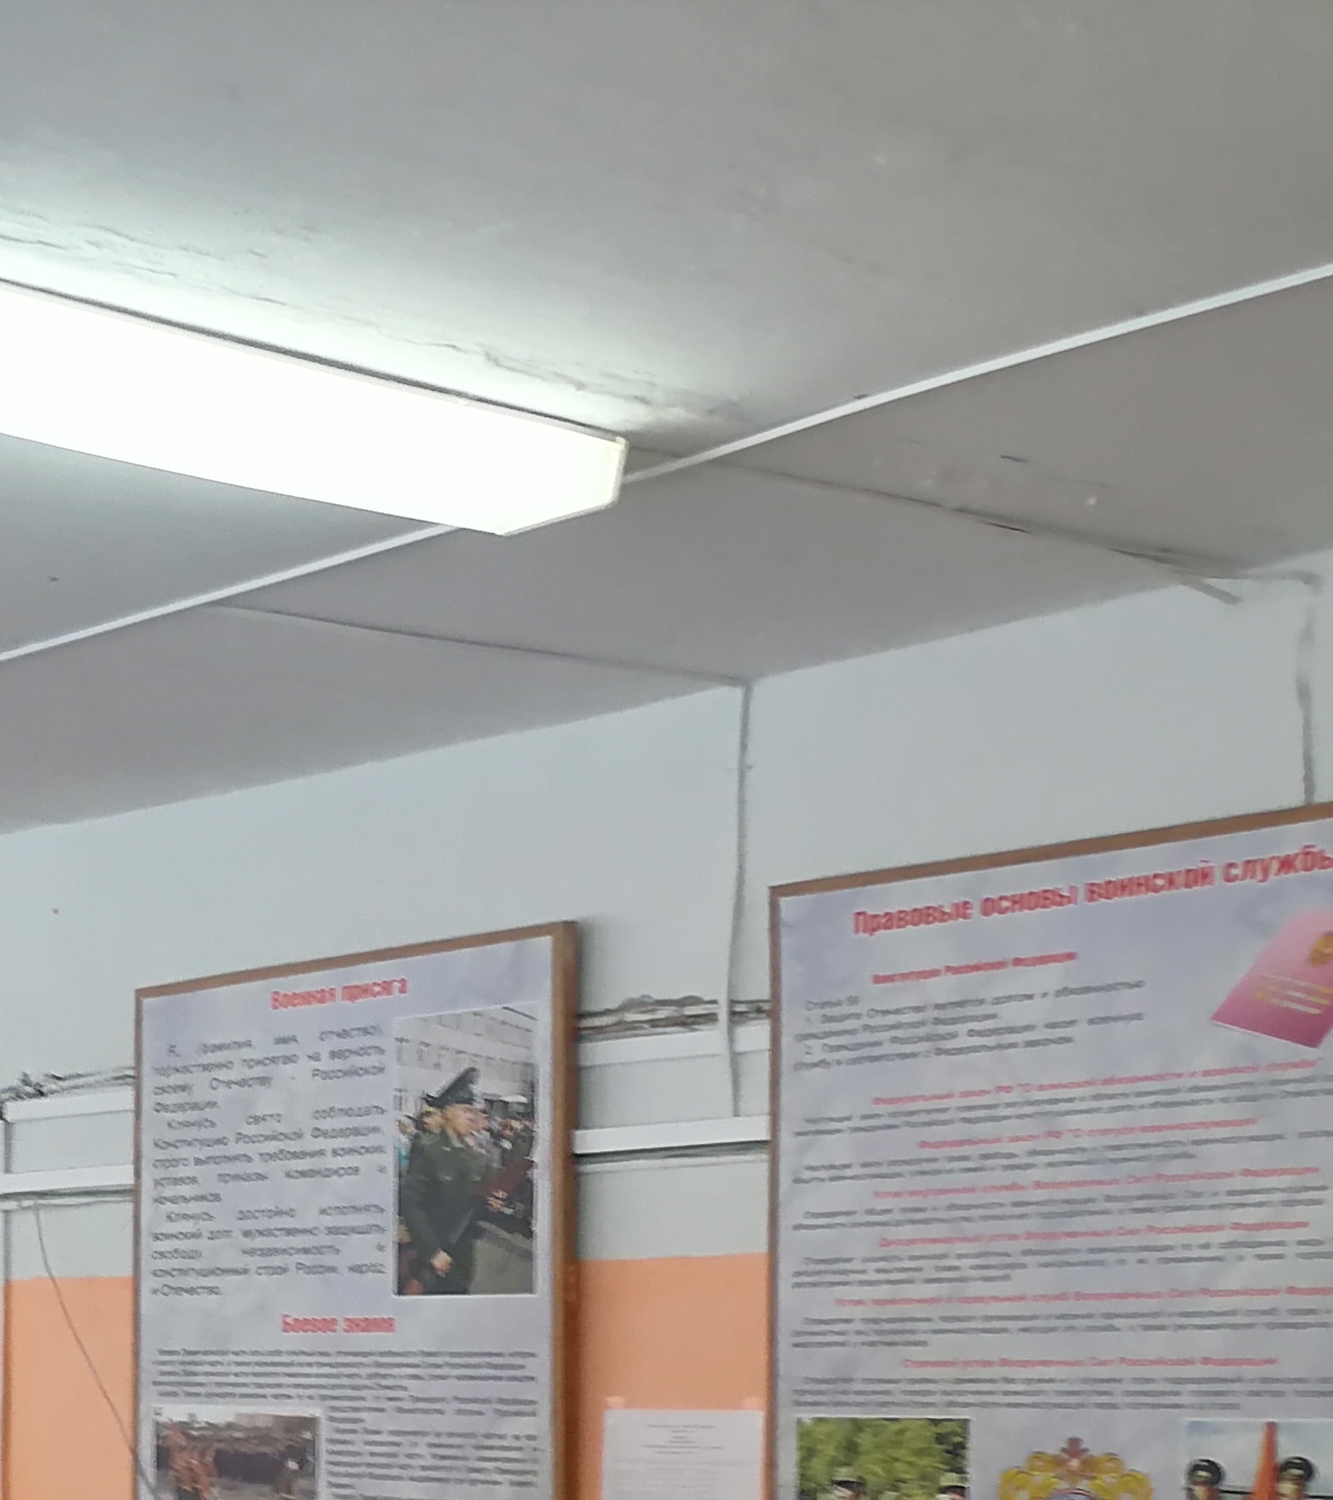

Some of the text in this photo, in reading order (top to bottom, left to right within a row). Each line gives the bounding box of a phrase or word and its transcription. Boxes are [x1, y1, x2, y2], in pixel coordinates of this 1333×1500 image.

[852, 899, 973, 936] Правовые
[980, 885, 1079, 918] основы
[1084, 858, 1215, 904] воинской
[270, 978, 408, 1011] Военная присяга
[280, 1313, 397, 1334] Боевое знамя
